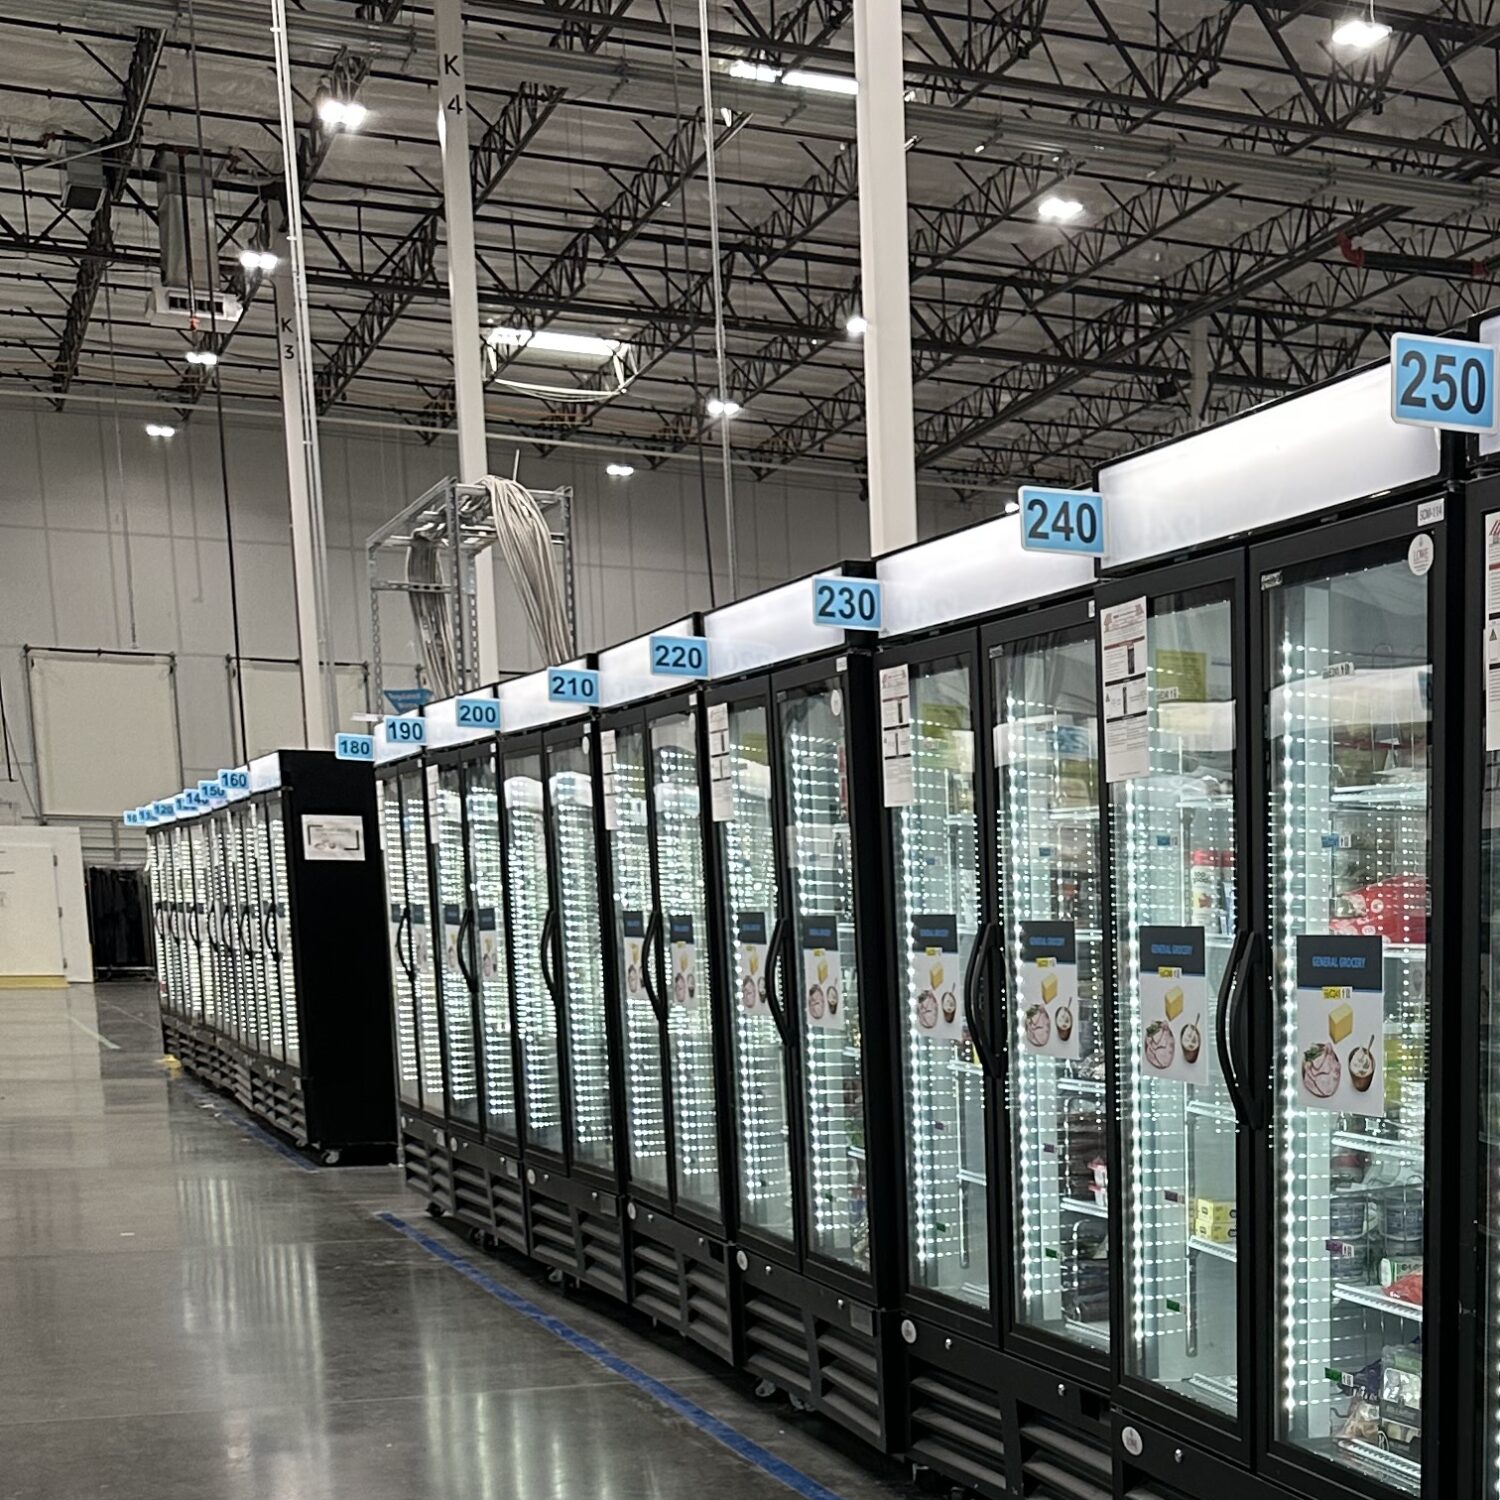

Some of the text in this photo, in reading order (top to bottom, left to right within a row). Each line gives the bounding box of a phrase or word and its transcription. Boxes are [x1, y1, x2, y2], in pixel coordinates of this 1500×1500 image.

[444, 54, 459, 76] K
[447, 95, 462, 115] 4
[282, 318, 293, 333] K
[284, 345, 294, 359] 3
[1400, 350, 1486, 414] 250
[1027, 499, 1097, 544] 240
[817, 586, 875, 621] 230
[655, 645, 702, 669] 220
[552, 676, 594, 698] 210
[460, 704, 496, 724] 200
[388, 721, 423, 741] 190
[340, 740, 370, 755] 180
[222, 773, 247, 788] 160
[155, 804, 174, 814] 120
[1311, 956, 1366, 969] GENERAL GROCERY
